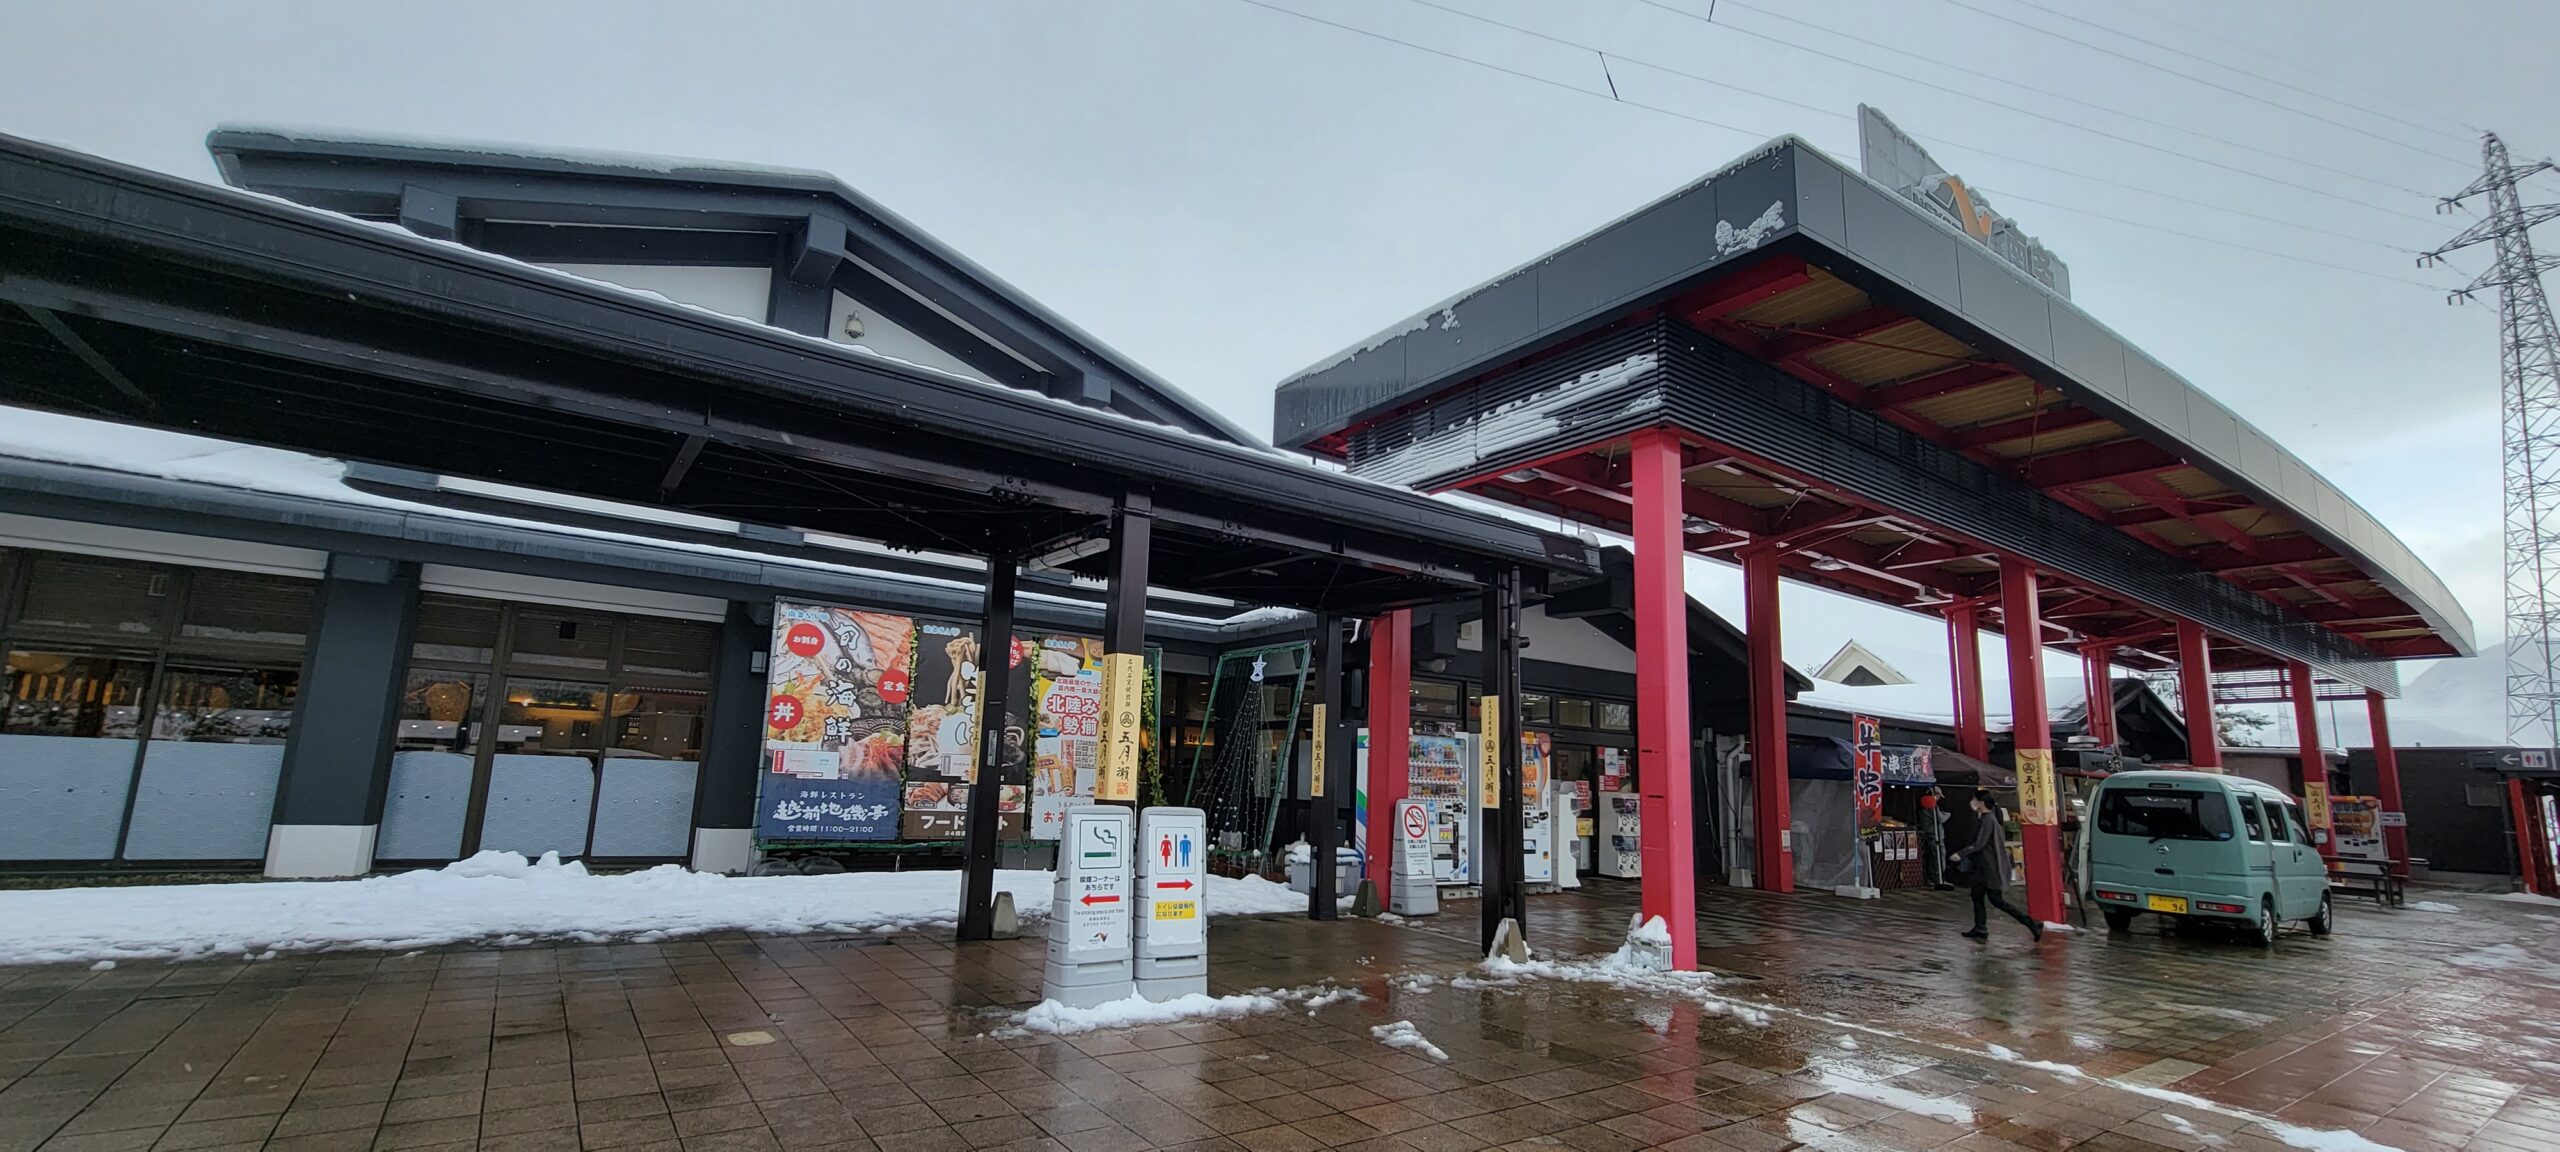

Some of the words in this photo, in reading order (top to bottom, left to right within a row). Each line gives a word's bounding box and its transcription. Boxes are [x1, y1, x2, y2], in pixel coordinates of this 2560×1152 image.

[824, 622, 860, 743] 旬の海鮮
[883, 681, 906, 692] 定食
[773, 702, 795, 722] 丼
[800, 790, 865, 800] 海鮮レストラン
[787, 824, 818, 833] 営業時間
[1079, 875, 1120, 883] 喫煙コーナーは
[1085, 883, 1114, 891] あちらです
